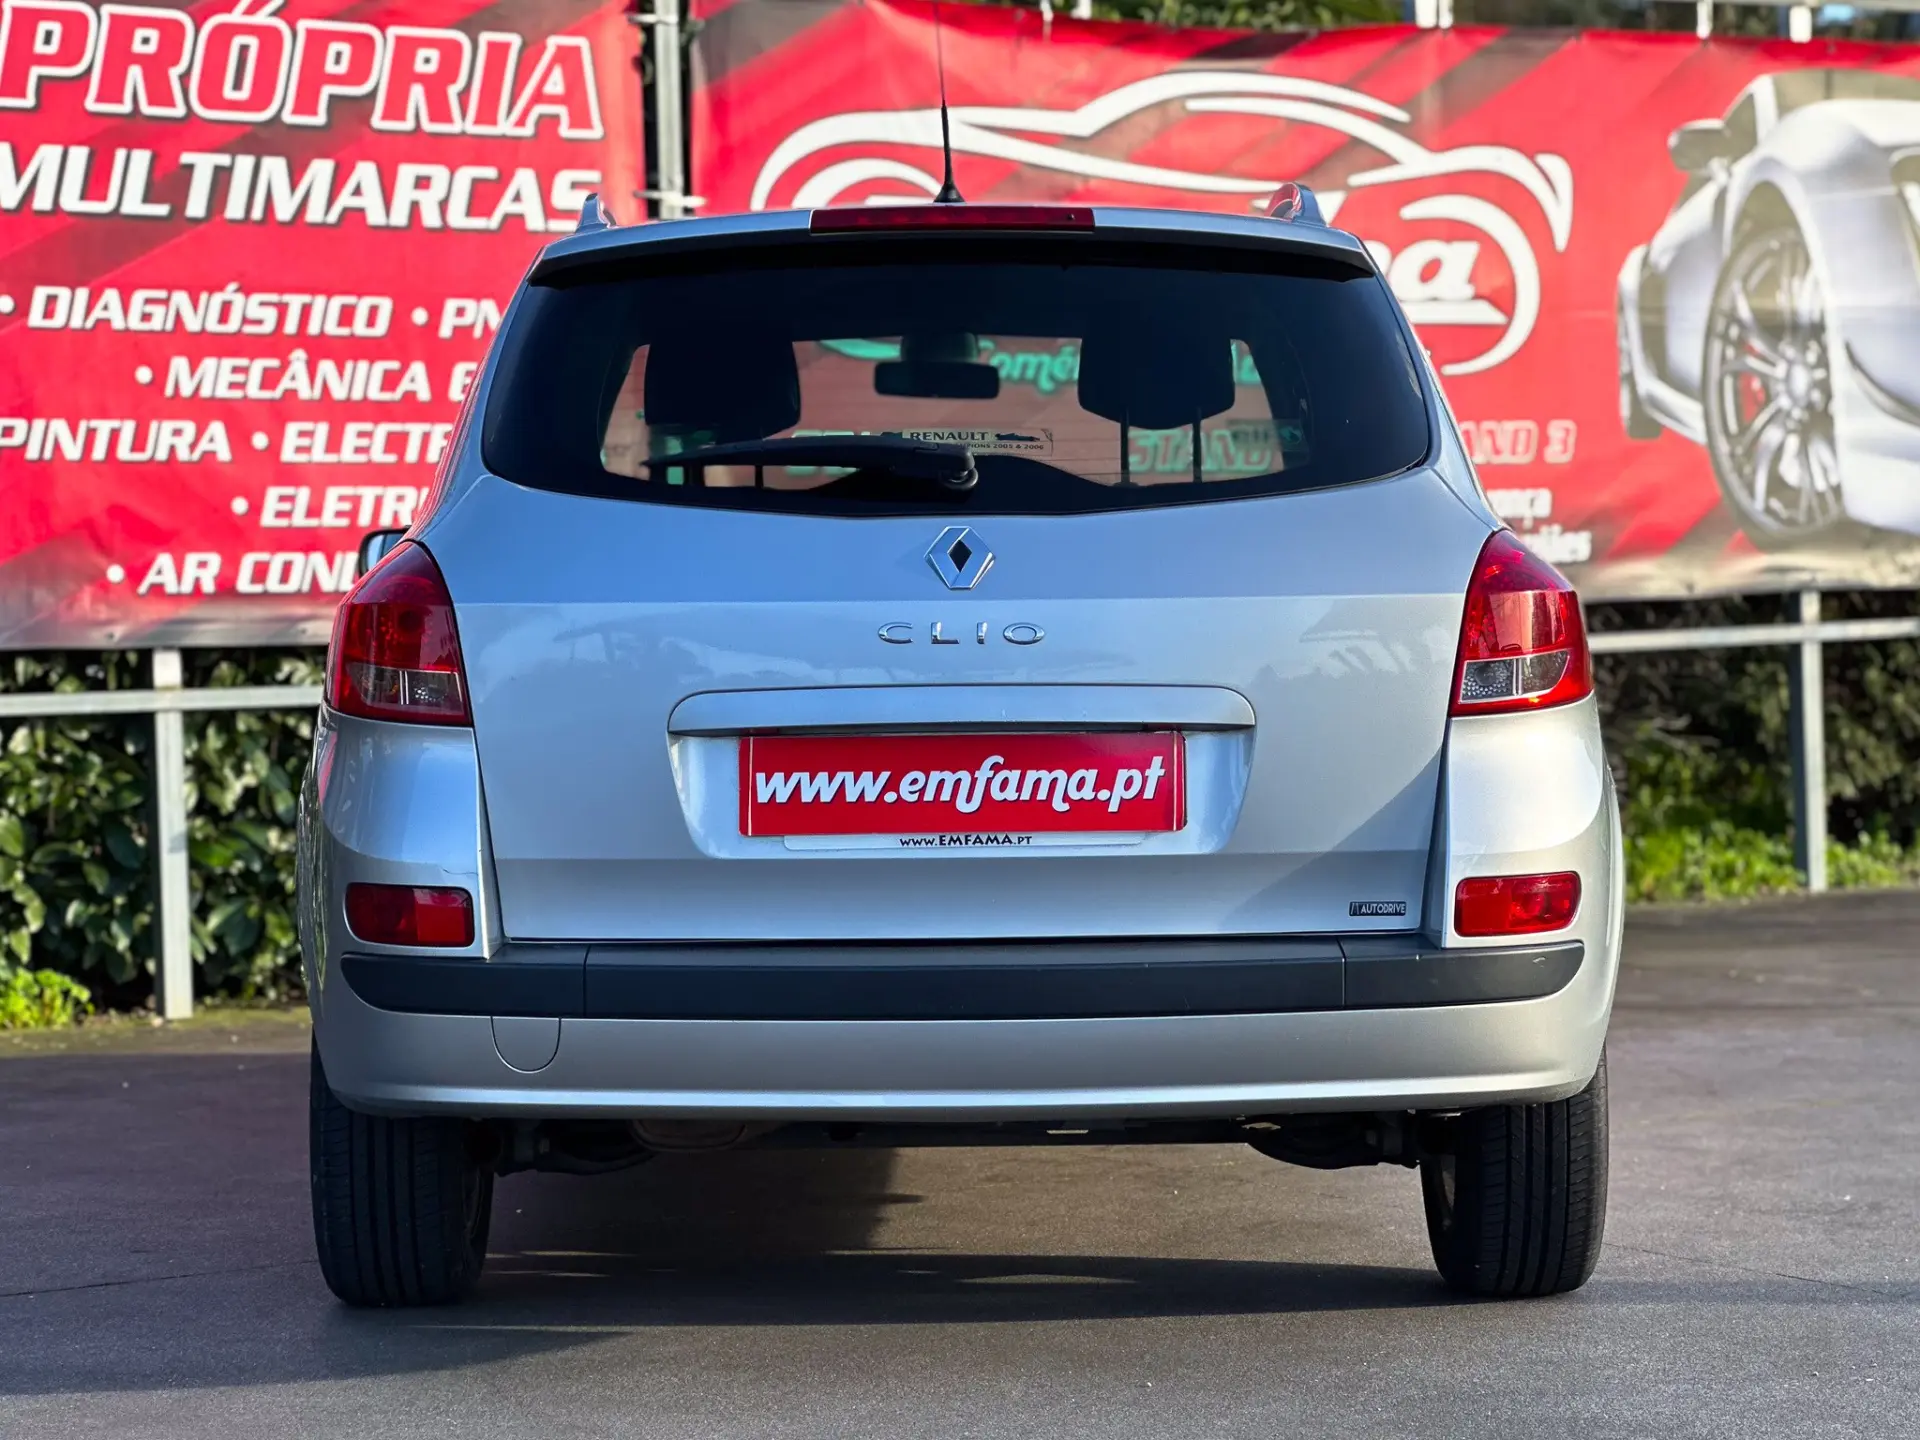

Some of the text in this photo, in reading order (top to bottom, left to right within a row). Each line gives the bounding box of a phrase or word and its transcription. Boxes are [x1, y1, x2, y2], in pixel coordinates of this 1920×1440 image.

[0, 0, 604, 139] PRÓPRIA
[0, 141, 603, 231] MULTIMARCAS
[27, 283, 393, 337] DIAGNÓSTICO
[165, 348, 432, 401] MECÂNICA
[0, 416, 231, 462] PINTURA
[910, 431, 989, 442] RENAULT
[1543, 419, 1577, 463] 3
[138, 553, 221, 595] AR
[877, 621, 1046, 645] CLIO
[755, 755, 1166, 814] www.emfama.pt
[1361, 903, 1406, 914] AUTODRIVE
